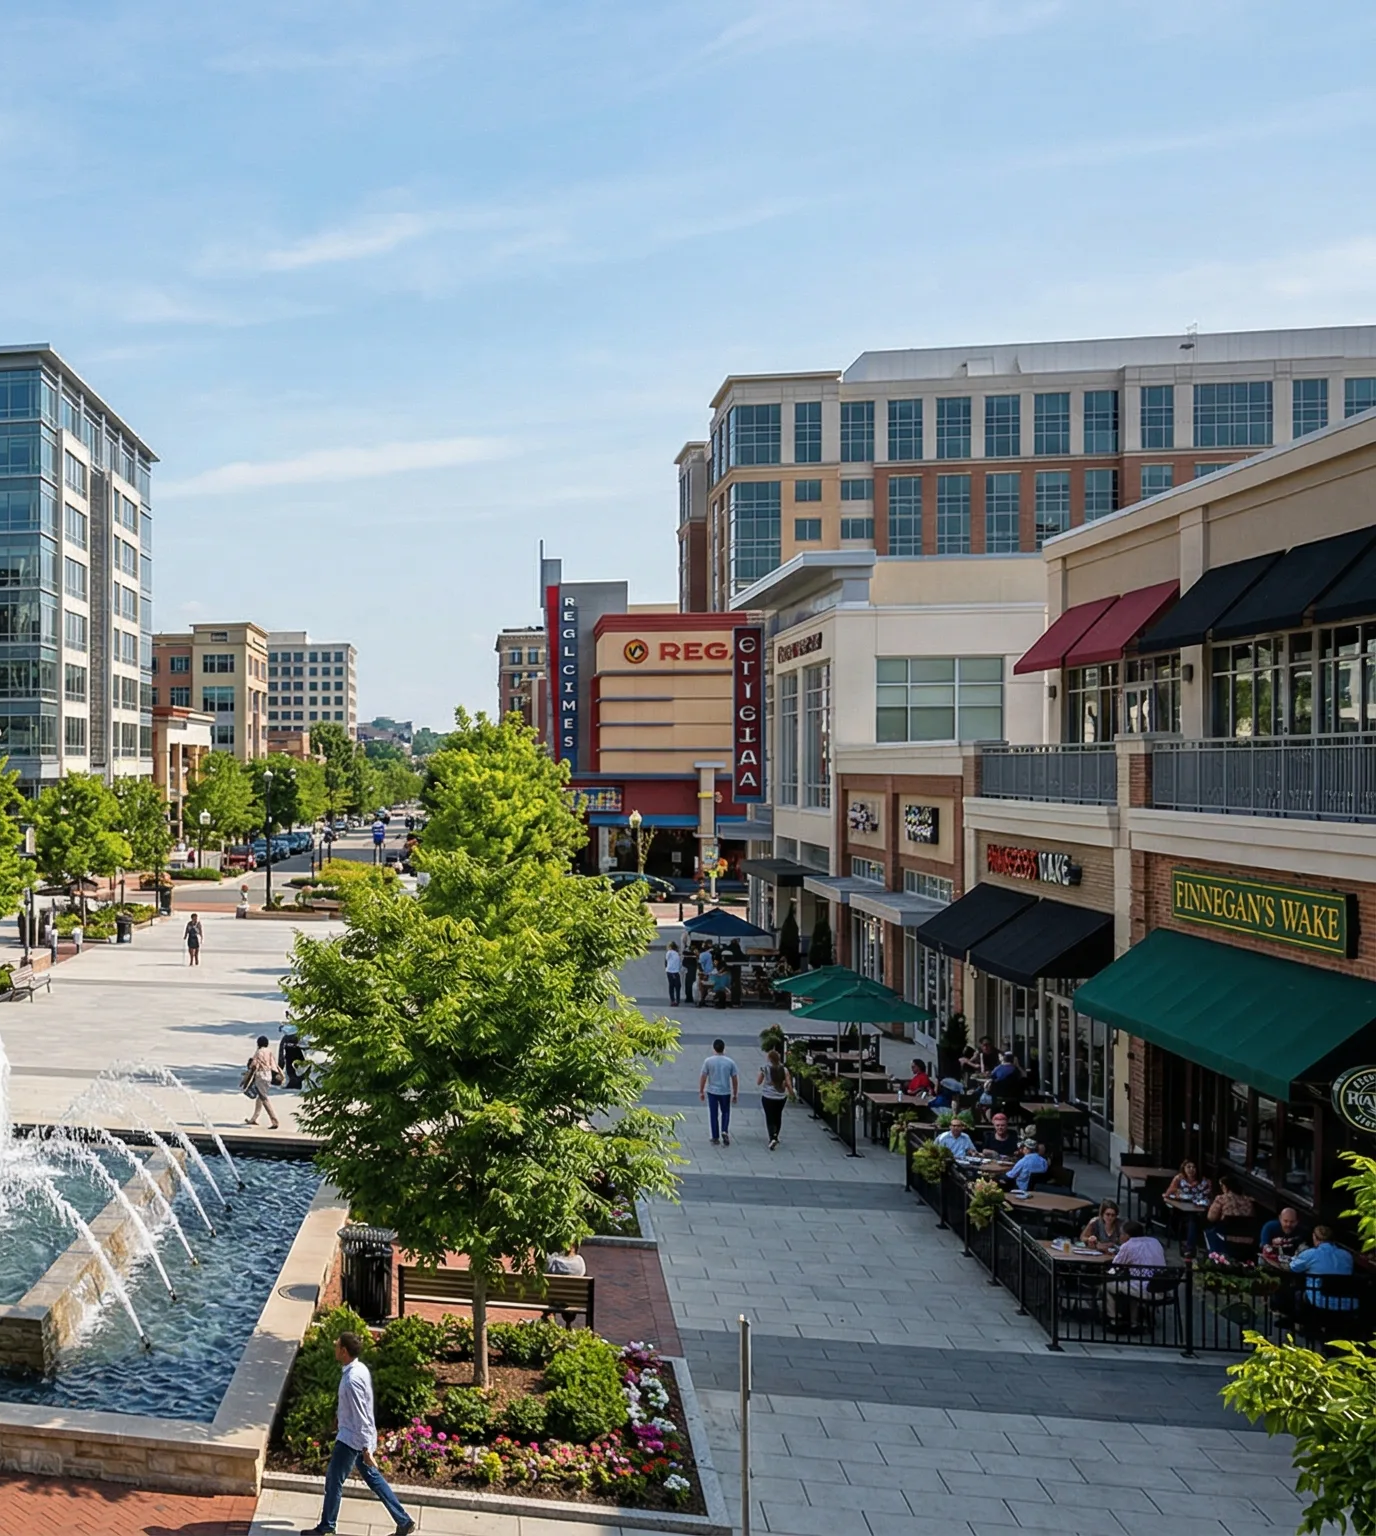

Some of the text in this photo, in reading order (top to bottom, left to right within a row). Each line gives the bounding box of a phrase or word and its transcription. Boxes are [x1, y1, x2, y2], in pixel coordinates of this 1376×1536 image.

[659, 642, 733, 661] REG
[1176, 881, 1340, 941] FINNEGAN'S WAKE
